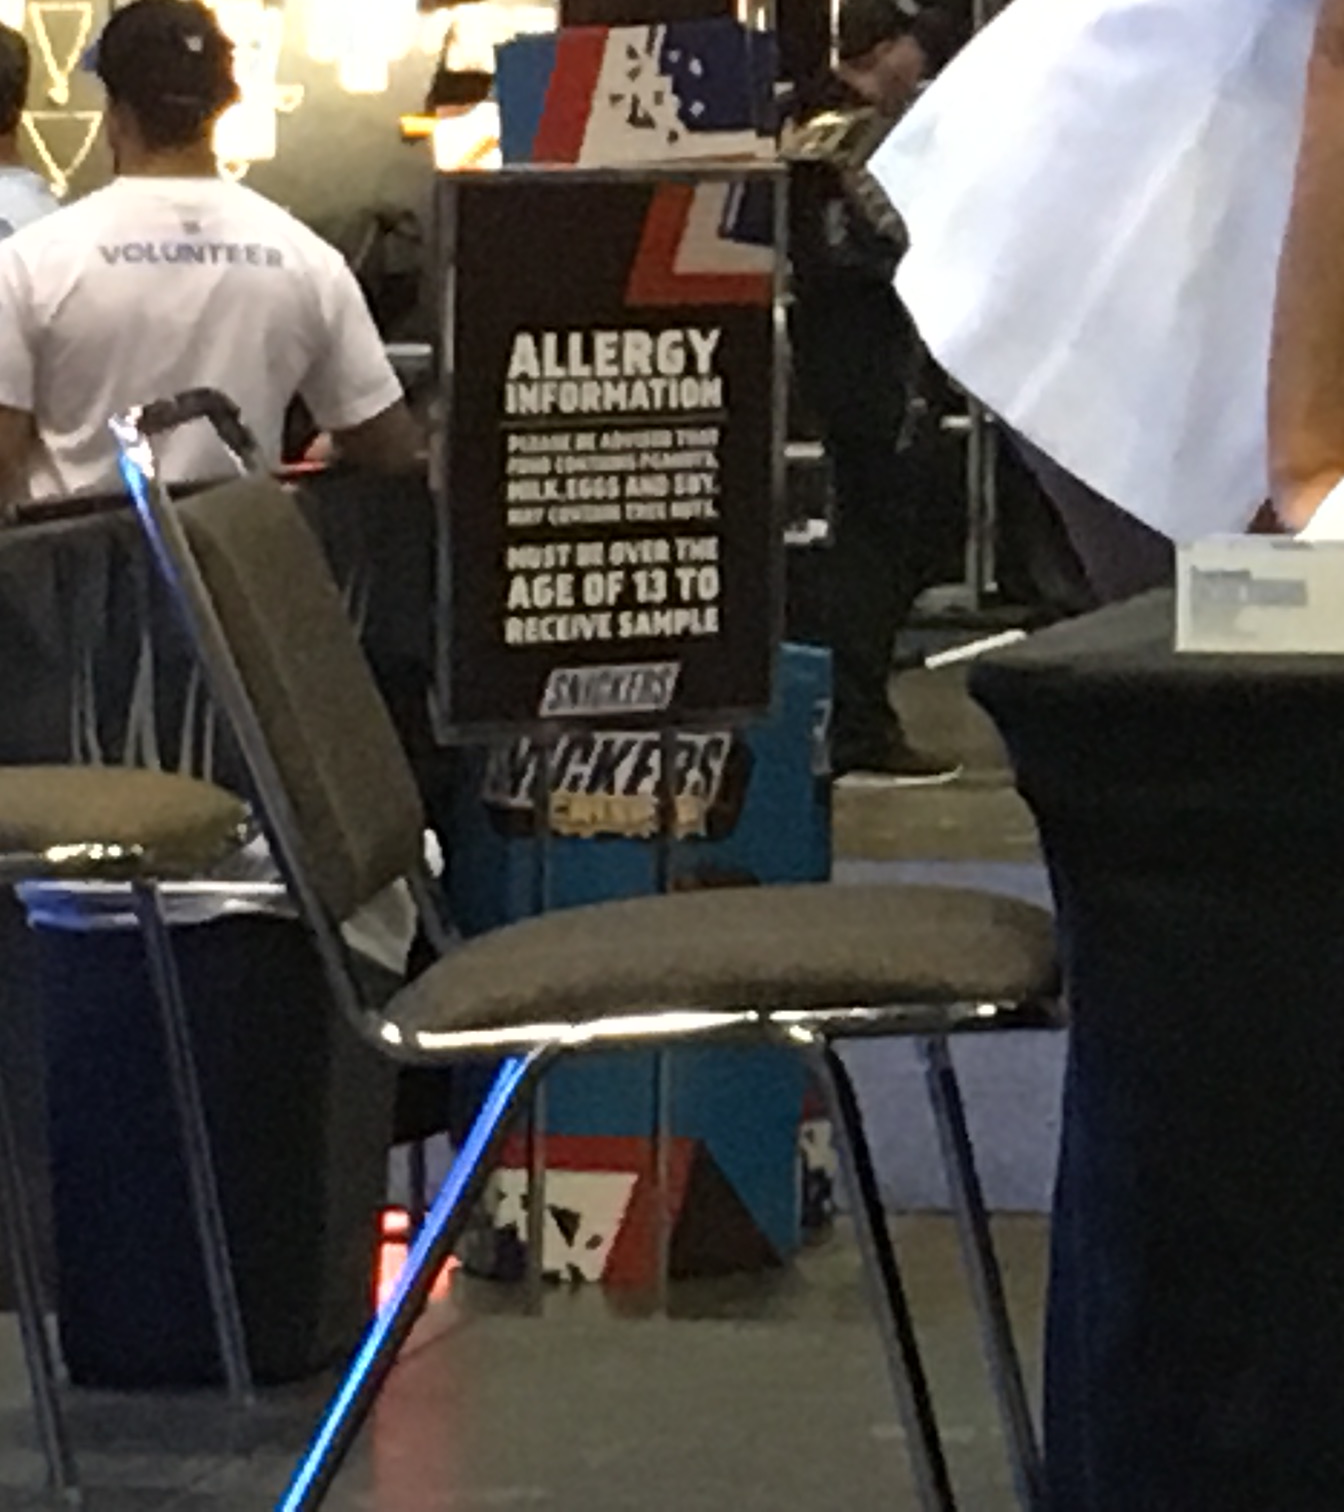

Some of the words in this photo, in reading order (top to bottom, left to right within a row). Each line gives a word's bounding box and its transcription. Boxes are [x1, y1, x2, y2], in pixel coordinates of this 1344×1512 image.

[98, 241, 285, 268] VOLUNTEER
[507, 328, 721, 379] ALLERGY
[504, 377, 723, 415] INFORMATION
[506, 544, 572, 570] MUST
[608, 538, 670, 565] OVER
[674, 535, 719, 561] THE
[506, 573, 575, 610] AGE
[583, 570, 624, 607] OF
[631, 567, 667, 604] 13
[674, 564, 719, 601] TO
[504, 612, 612, 644] RECEIVE
[618, 606, 719, 638] SAMPLE
